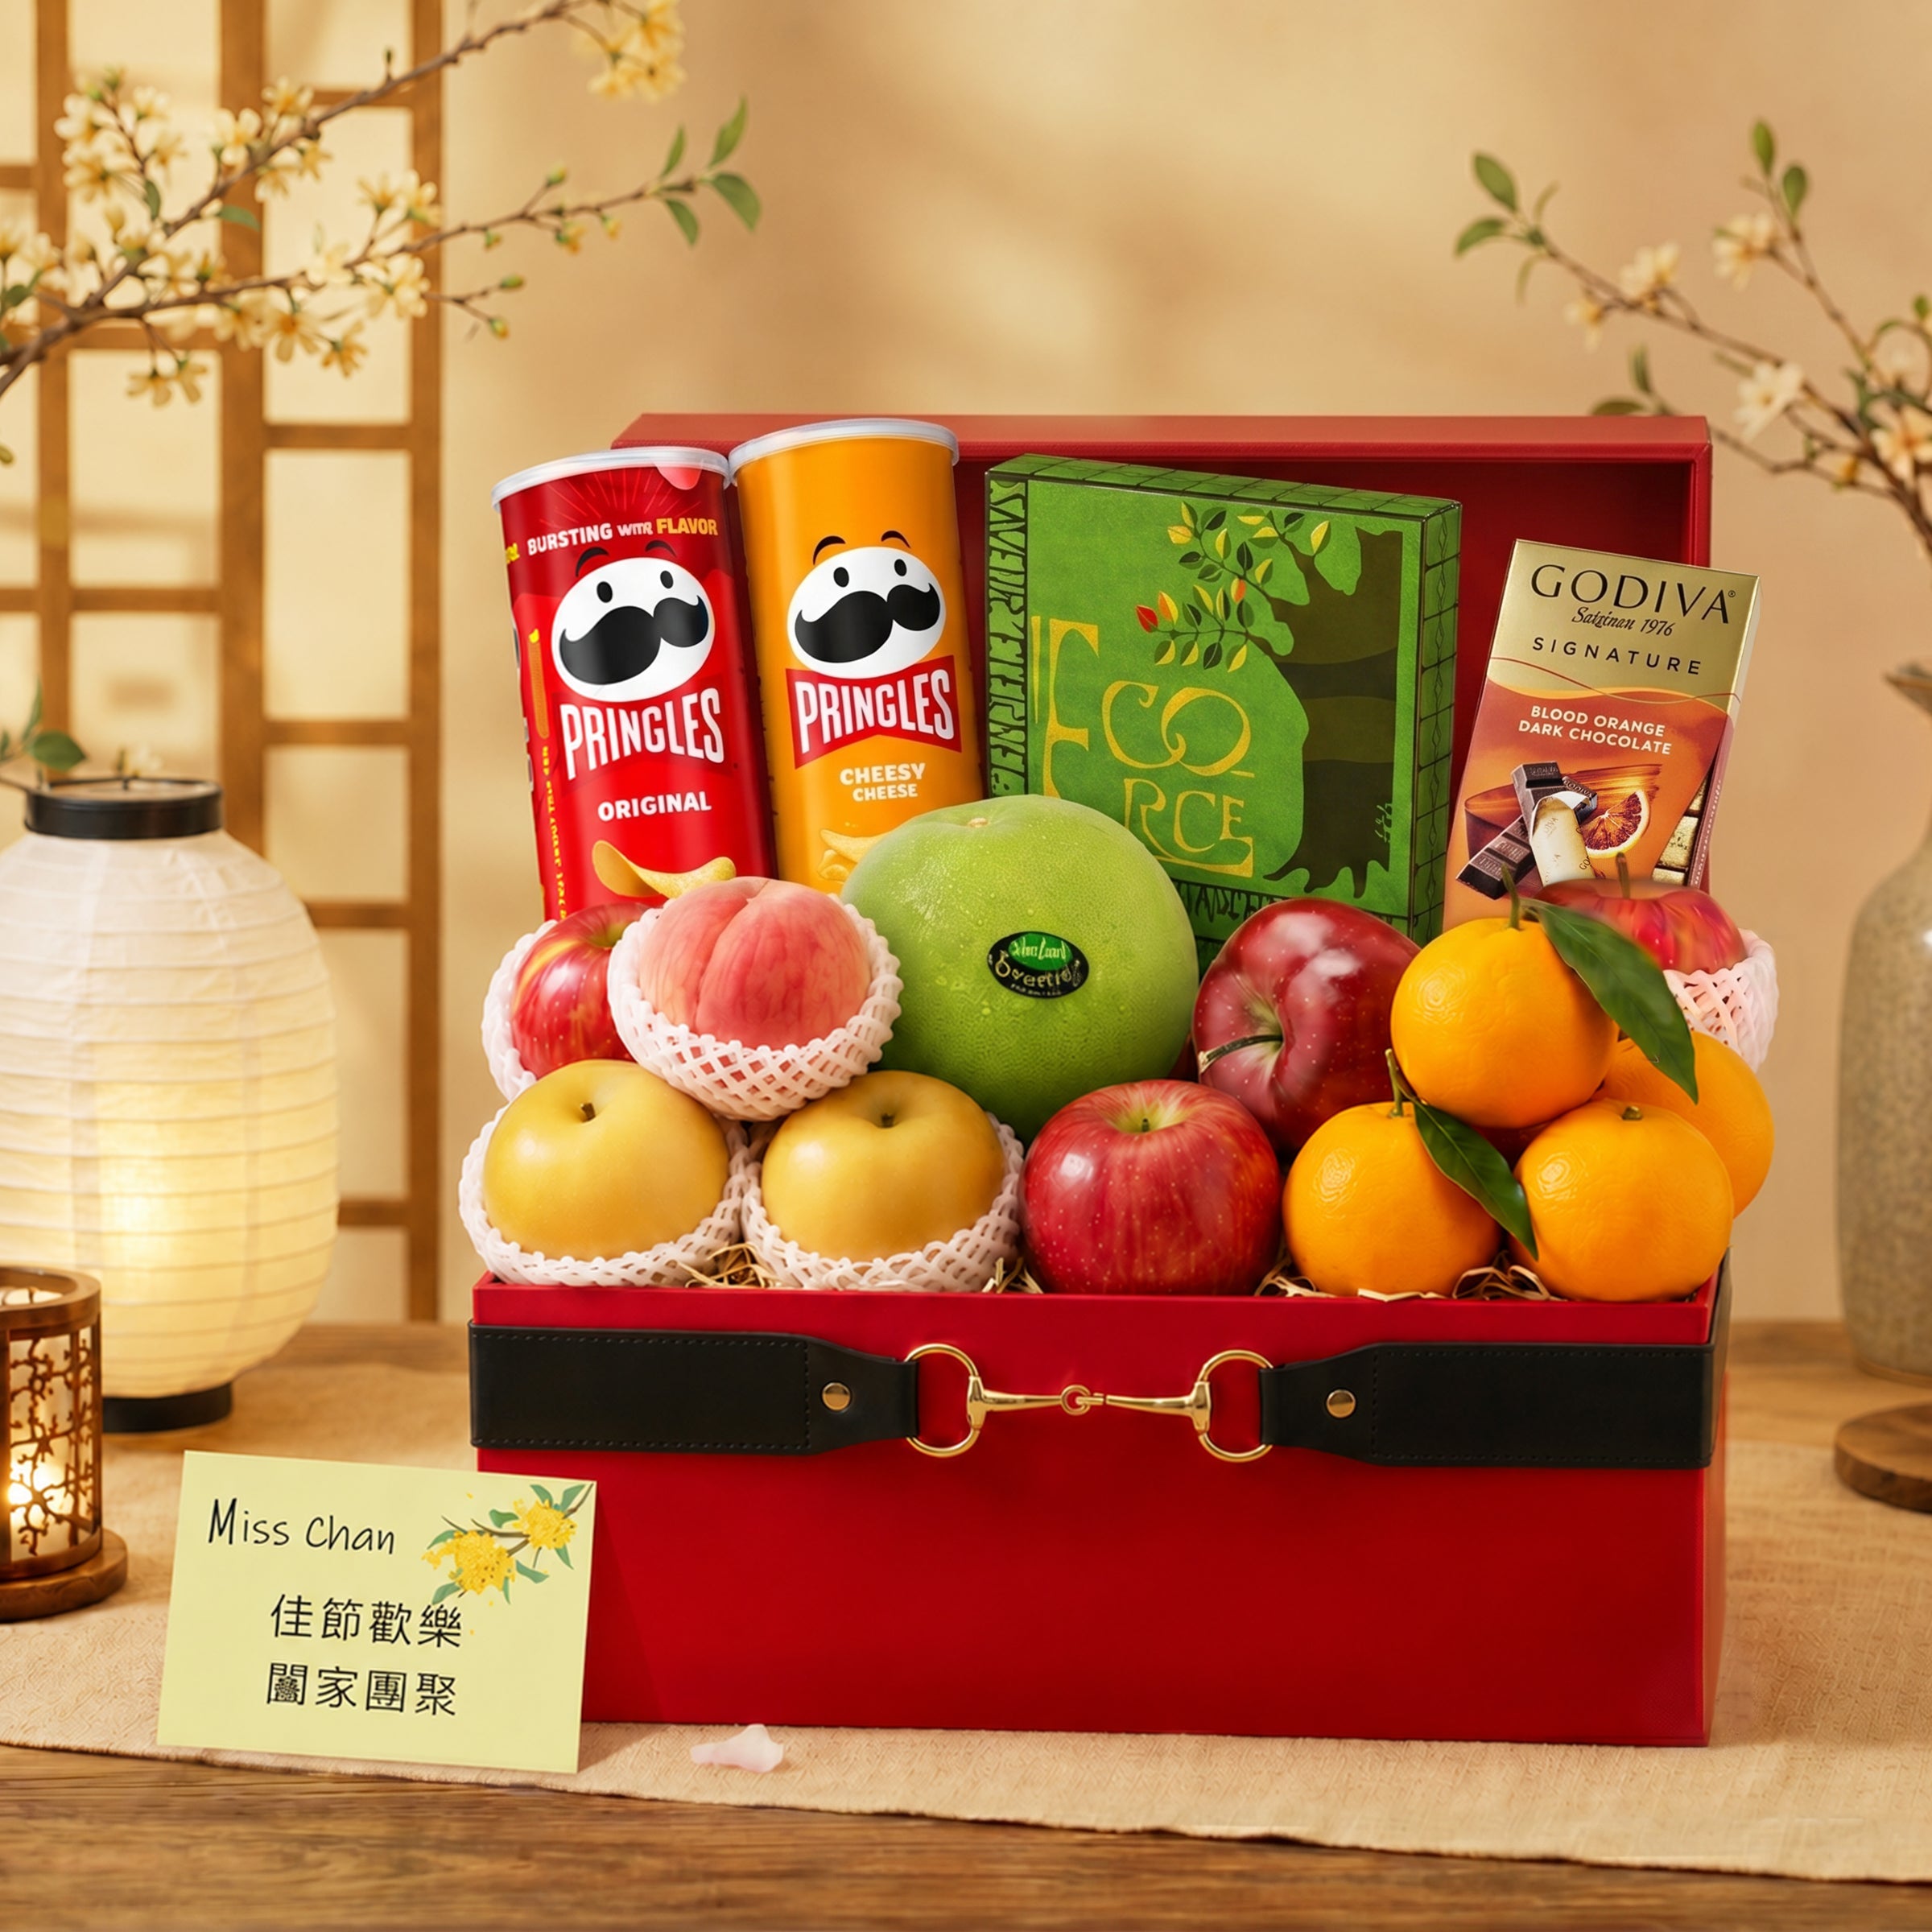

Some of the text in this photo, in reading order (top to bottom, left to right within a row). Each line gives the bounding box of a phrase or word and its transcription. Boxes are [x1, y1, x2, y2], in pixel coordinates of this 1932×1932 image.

[526, 523, 613, 555] BURSTING
[656, 518, 718, 535] FLAVOR
[1641, 619, 1676, 636] 1976
[1533, 637, 1702, 675] SIGNATURE
[795, 669, 955, 754] PRINGLES
[1531, 706, 1666, 737] BLOOD ORANGE
[560, 687, 724, 780] PRINGLES
[1518, 720, 1672, 754] DARK CHOCOLATE
[840, 763, 926, 786] CHEESY
[598, 791, 712, 821] ORIGINAL
[852, 784, 919, 802] CHEESE
[208, 1497, 395, 1554] Miss Chan
[270, 1593, 462, 1648] 佳節歡樂
